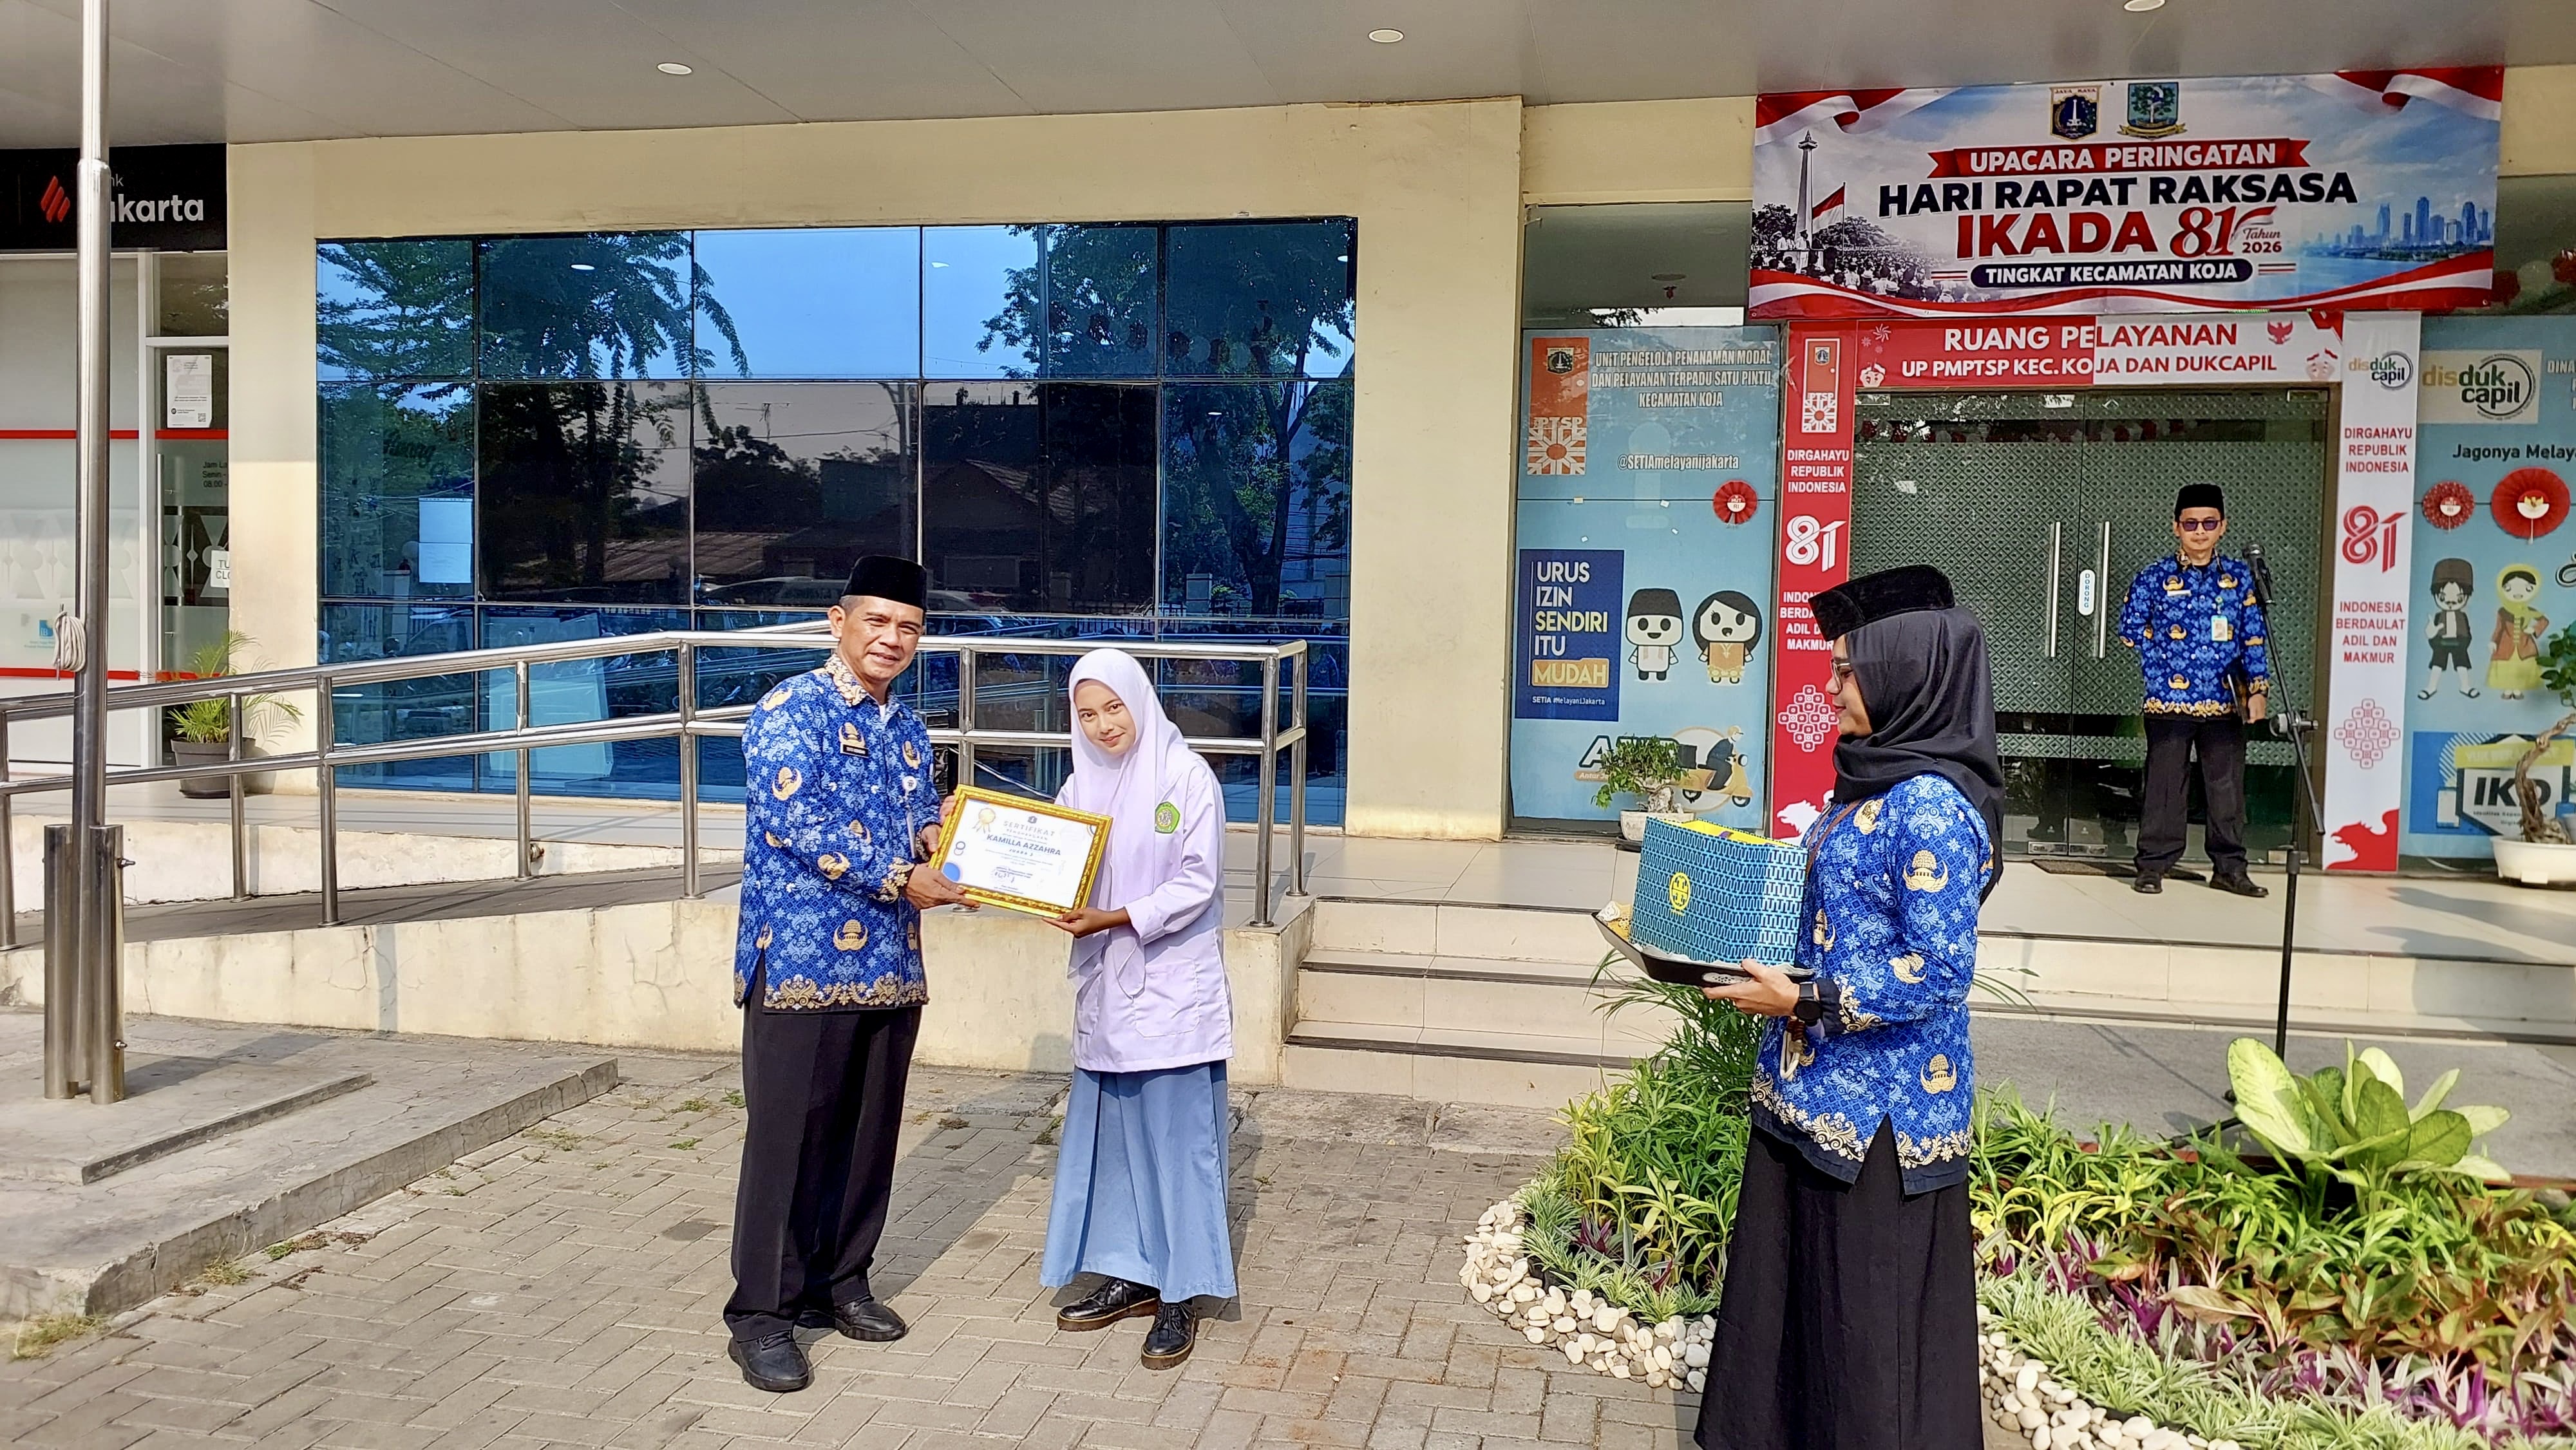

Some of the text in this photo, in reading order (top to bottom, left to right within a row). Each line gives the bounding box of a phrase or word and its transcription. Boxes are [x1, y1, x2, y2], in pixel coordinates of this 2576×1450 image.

[1970, 144, 2276, 173] UPACARA PERINGATAN
[1879, 172, 2358, 217] HARI RAPAT RAKSASA
[111, 194, 204, 222] karta
[1957, 206, 2235, 258] IKADA 81
[2242, 227, 2282, 241] Tahun
[2242, 242, 2282, 253] 2026
[1985, 263, 2238, 284] TINGKAT KECAMATAN KOJA
[1944, 323, 2237, 351] RUANG PELAYANAN
[1595, 350, 1772, 367] UNIT PENGELOLA PENANAMAN MODAL
[1902, 361, 1928, 377] UP
[1933, 359, 2009, 377] PMPTSP
[2126, 357, 2169, 373] DAN
[2176, 355, 2277, 371] DUKCAPIL
[1591, 370, 1772, 388] DAN PELAYANAN TERPADU SATU PINTU
[2372, 368, 2405, 384] capil
[1639, 391, 1723, 408] KECAMATAN KOJA
[2461, 381, 2520, 410] capil
[2344, 428, 2412, 439] DIRGAHAYU
[1787, 449, 1849, 462] DIRGAHAYU
[2349, 445, 2407, 455] REPUBLIK
[2452, 444, 2520, 461] Jagonya
[1618, 454, 1739, 471] @SETIAmelayanijakarta
[2346, 462, 2409, 473] INDONESIA
[1790, 466, 1844, 477] REPUBLIK
[1788, 482, 1846, 493] INDONESIA
[1786, 515, 1846, 572] 81
[2342, 505, 2407, 574] 81
[1537, 561, 1591, 583] URUS
[1536, 587, 1573, 607] IZIN
[2340, 602, 2403, 614] INDONESIA
[1535, 612, 1607, 632] SENDIRI
[1786, 623, 1810, 634] ADIL
[2336, 618, 2405, 630] BERDAULAT
[1535, 636, 1566, 655] ITU
[2343, 636, 2397, 646] ADIL DAN
[2344, 652, 2394, 664] MAKMUR
[1533, 663, 1606, 686] MUDAH
[1003, 820, 1056, 836] SERTIFIKAT
[987, 834, 1021, 847] KAMILLA
[1023, 842, 1061, 855] AZZAHRA
